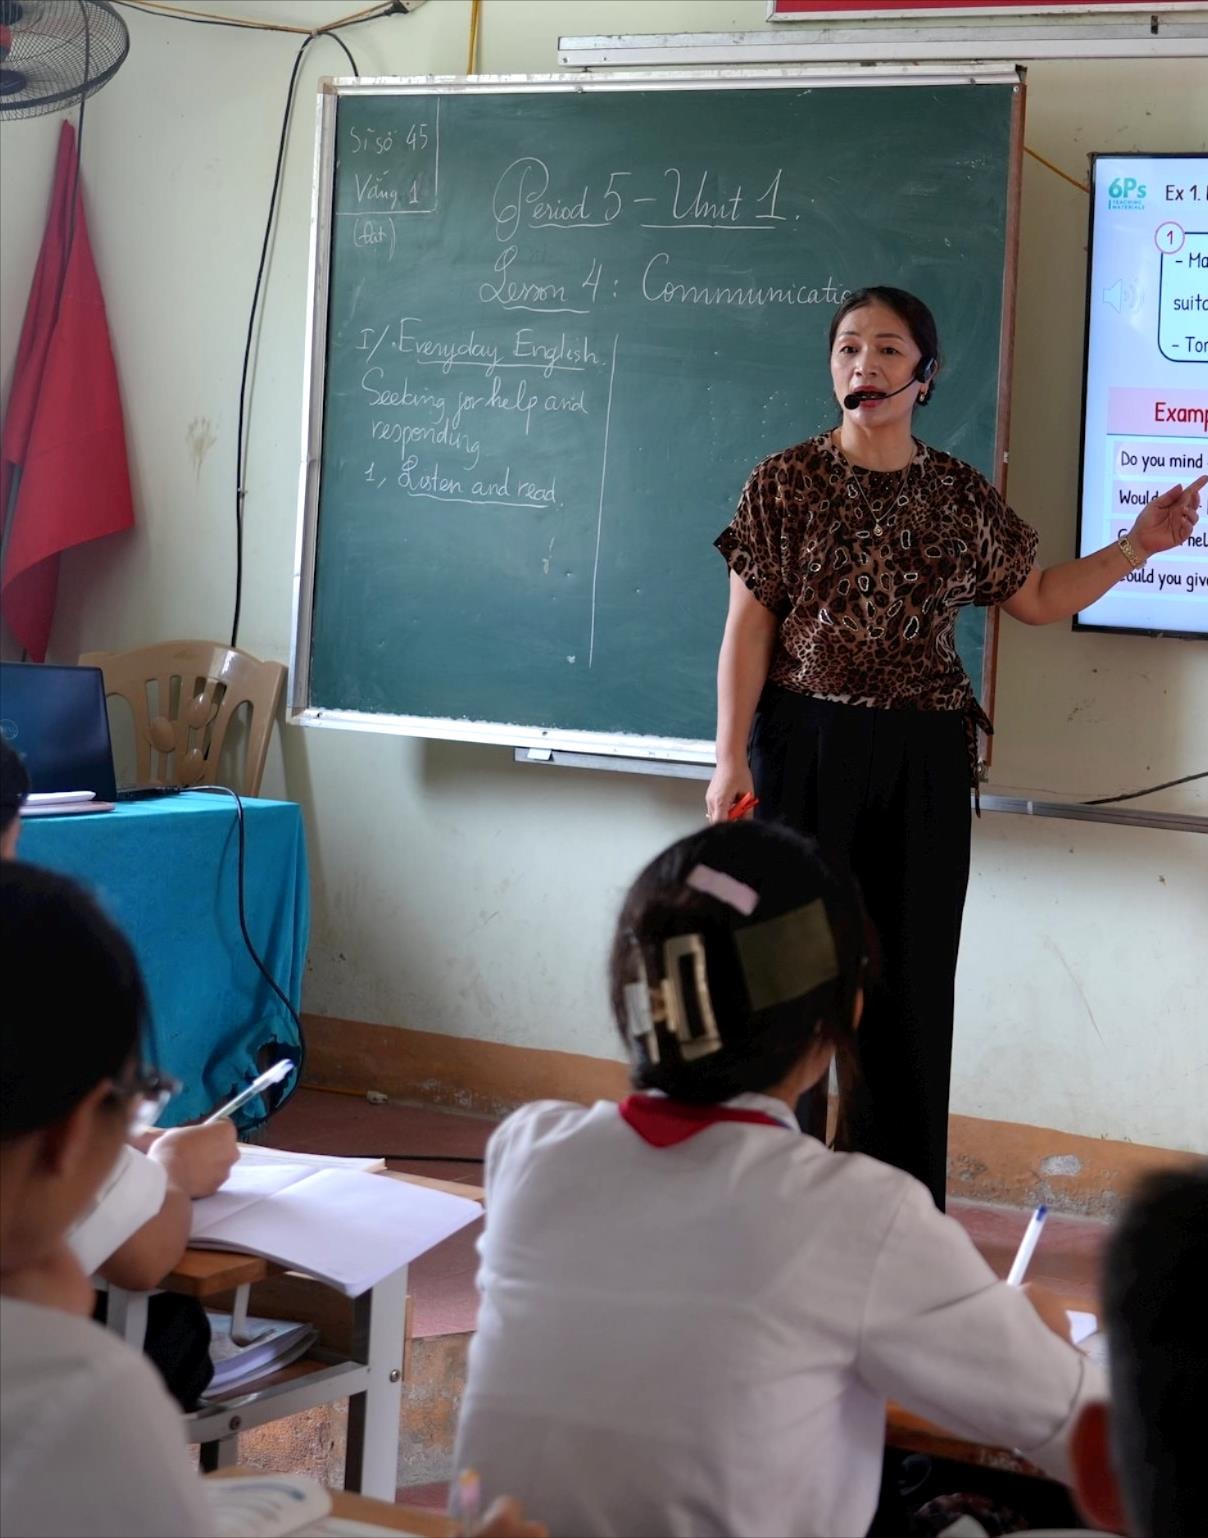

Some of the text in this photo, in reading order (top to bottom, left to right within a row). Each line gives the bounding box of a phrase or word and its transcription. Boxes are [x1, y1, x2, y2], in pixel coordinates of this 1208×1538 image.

[406, 123, 428, 151] 45
[408, 179, 419, 205] 1
[493, 157, 591, 242] Period
[604, 172, 632, 222] 5
[664, 168, 743, 221] Unit
[1108, 177, 1147, 199] 6Ps
[1166, 185, 1184, 200] Ex
[1190, 185, 1200, 200] 1.
[1167, 231, 1173, 244] 1
[480, 246, 567, 304] Lesson
[643, 252, 851, 306] Communicatio
[399, 317, 504, 377] Everyday
[361, 366, 588, 435] Seeking for help and
[372, 418, 479, 470] responding
[398, 454, 464, 495] Listen
[471, 465, 511, 497] and
[1121, 451, 1137, 466] Do
[1142, 456, 1165, 472] you
[1170, 454, 1202, 468] mind
[1120, 568, 1154, 584] ould
[1158, 574, 1181, 590] you
